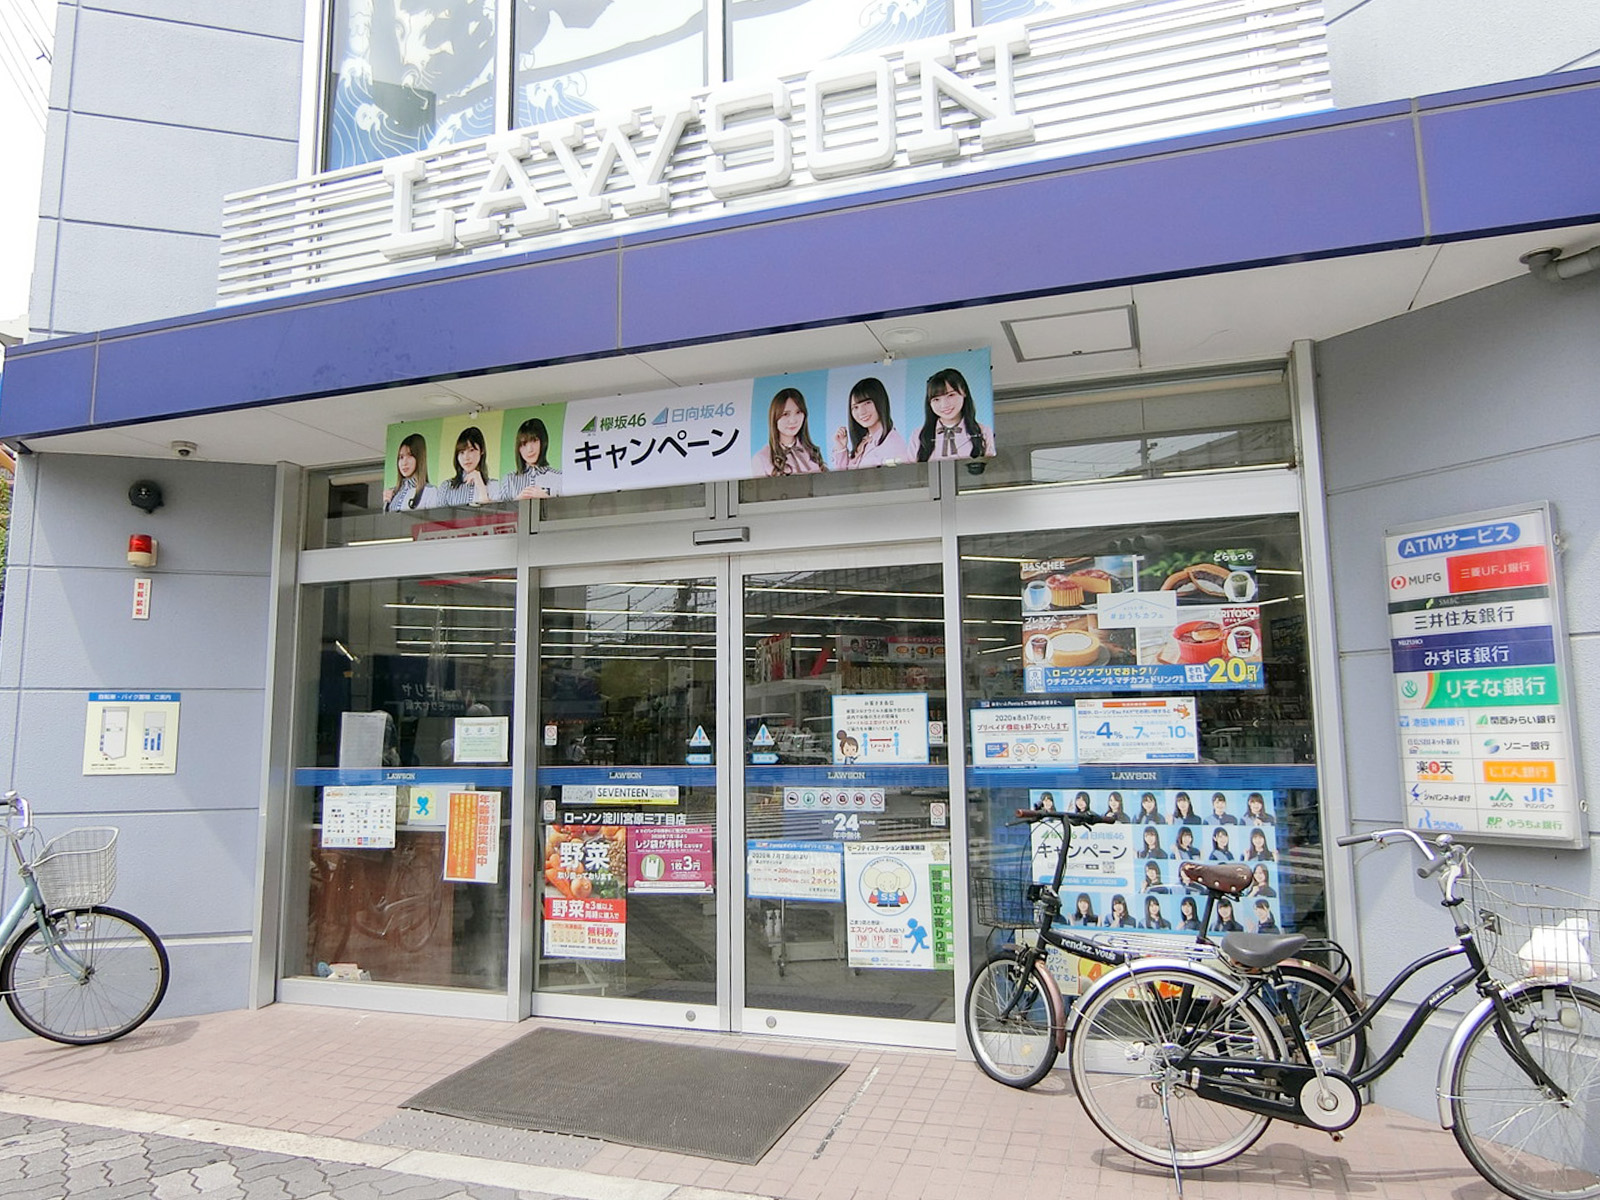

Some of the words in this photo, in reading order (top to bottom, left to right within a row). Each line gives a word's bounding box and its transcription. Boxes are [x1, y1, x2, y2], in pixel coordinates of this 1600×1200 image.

[380, 24, 1036, 260] LAWSON
[600, 412, 647, 431] 欅坂46
[672, 402, 735, 423] 日向坂46
[574, 428, 740, 471] キャンペーン
[1403, 524, 1514, 556] ATMサービス
[1213, 551, 1254, 562] どらもっち
[1408, 572, 1442, 586] MUFG
[1460, 561, 1530, 579] 三菱UFJ銀行
[1414, 606, 1515, 630] 三井住友銀行
[1424, 645, 1510, 667] みずほ銀行
[1208, 658, 1247, 683] 20
[1446, 676, 1546, 699] りそな銀行
[1490, 715, 1556, 725] 関西みらい銀行
[1504, 740, 1550, 751] ソニー銀行
[597, 787, 649, 797] SEVENTEEN
[834, 812, 859, 831] 24
[560, 842, 611, 869] 野菜
[880, 892, 896, 901] SS
[551, 899, 585, 918] 野菜
